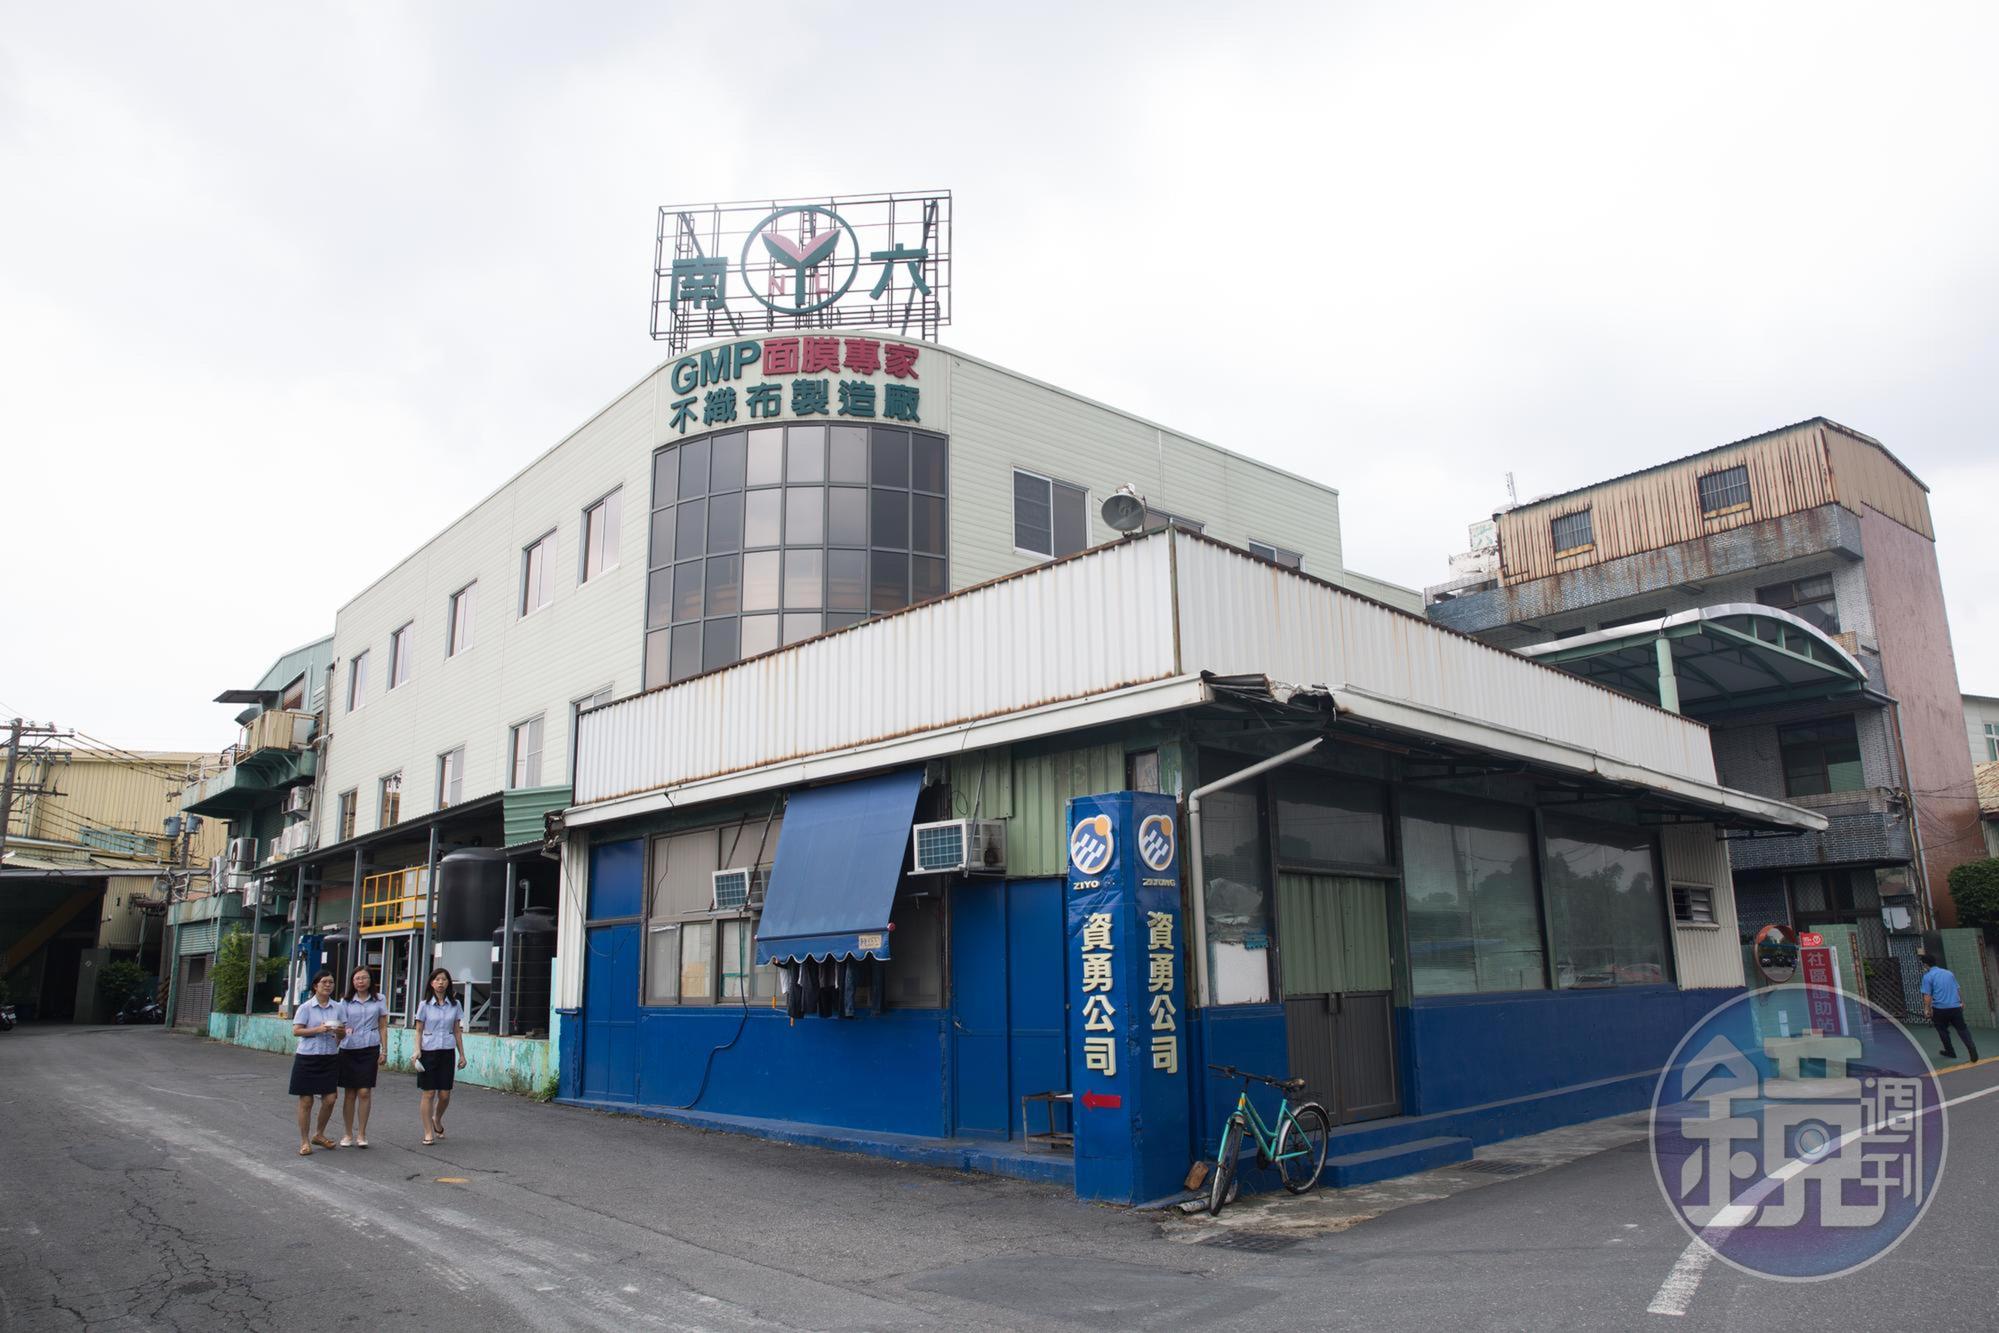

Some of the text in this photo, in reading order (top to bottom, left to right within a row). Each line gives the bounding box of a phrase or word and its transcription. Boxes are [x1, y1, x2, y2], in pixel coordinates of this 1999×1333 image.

[669, 379, 920, 434] 不織布製造廠
[1081, 912, 1116, 1076] 資勇公司
[1147, 911, 1177, 1074] 資勇公司
